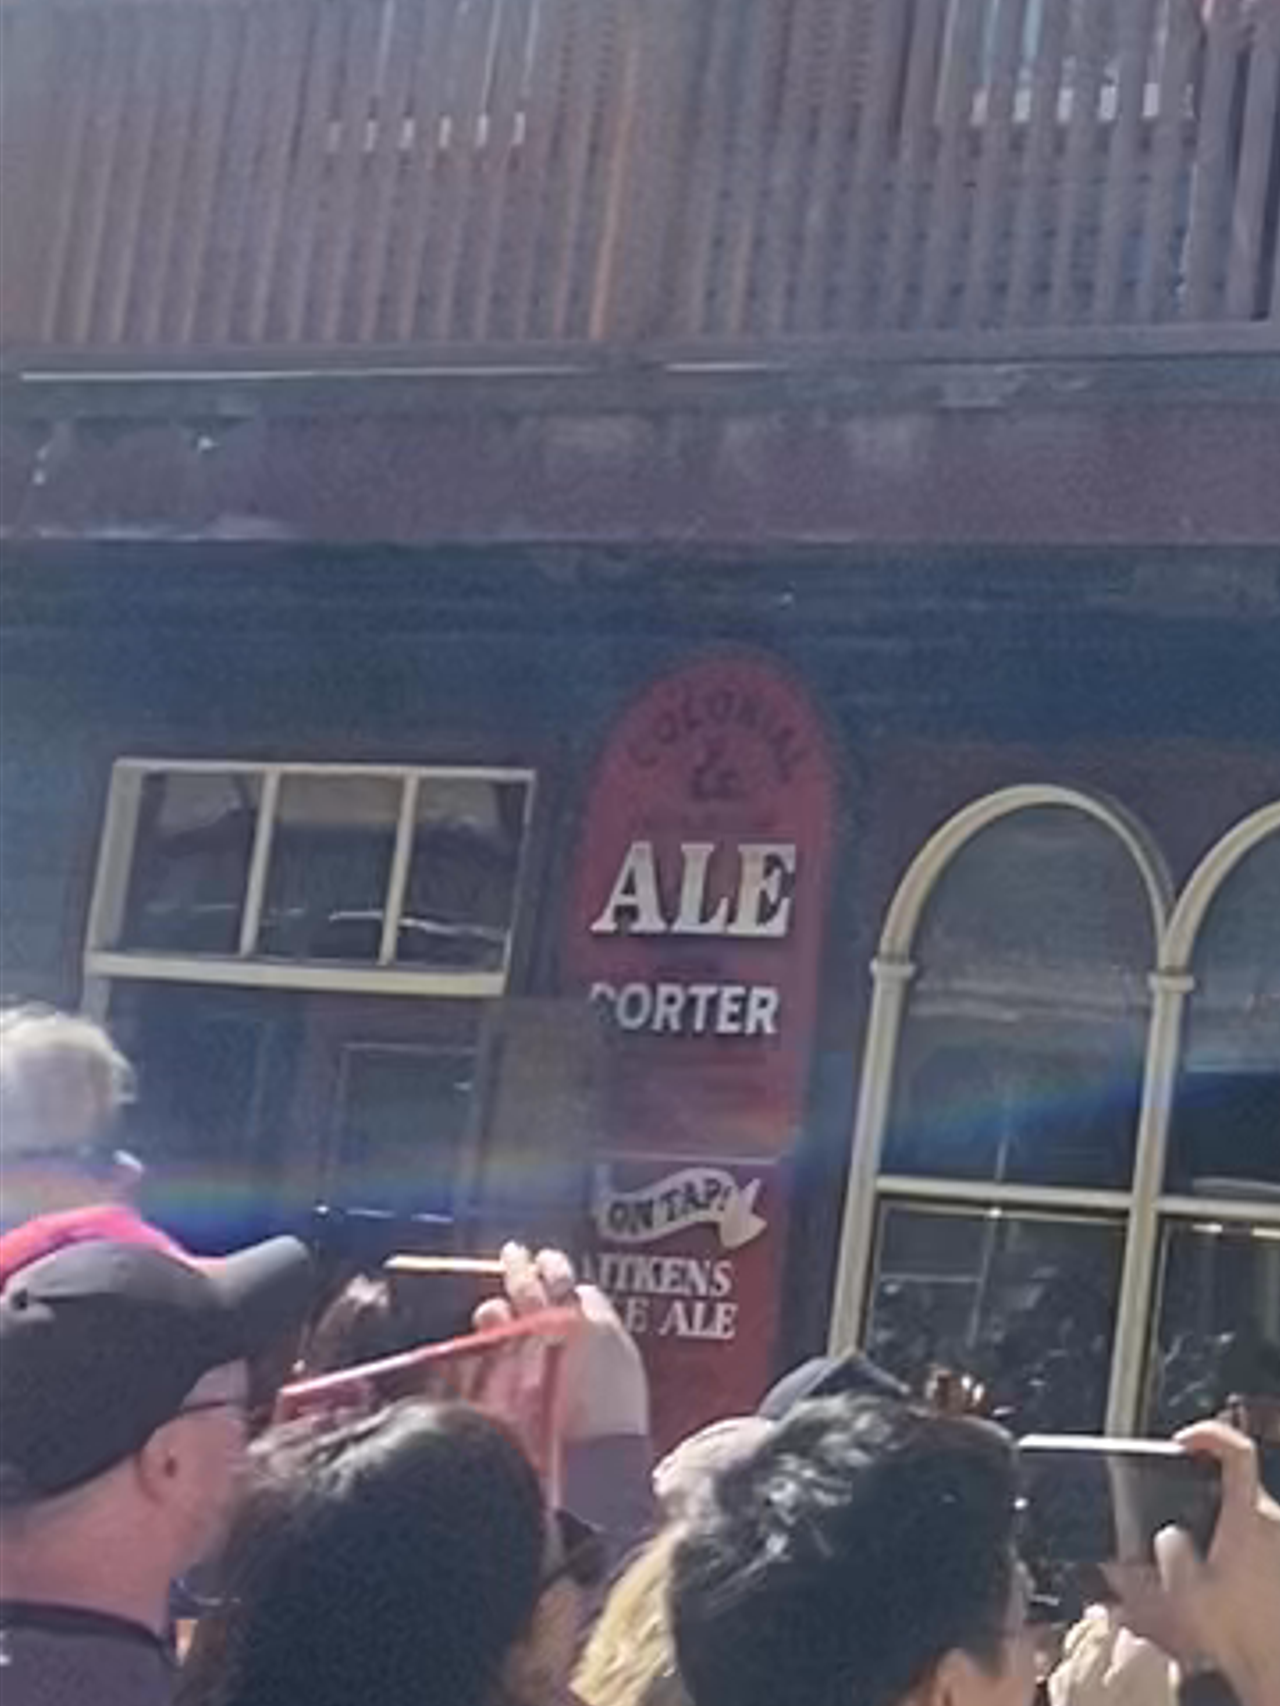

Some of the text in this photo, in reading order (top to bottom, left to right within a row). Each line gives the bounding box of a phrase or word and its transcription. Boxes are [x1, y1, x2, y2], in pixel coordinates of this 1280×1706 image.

[589, 841, 796, 937] ALE
[608, 1199, 654, 1237] ON
[659, 1300, 738, 1340] ALE
